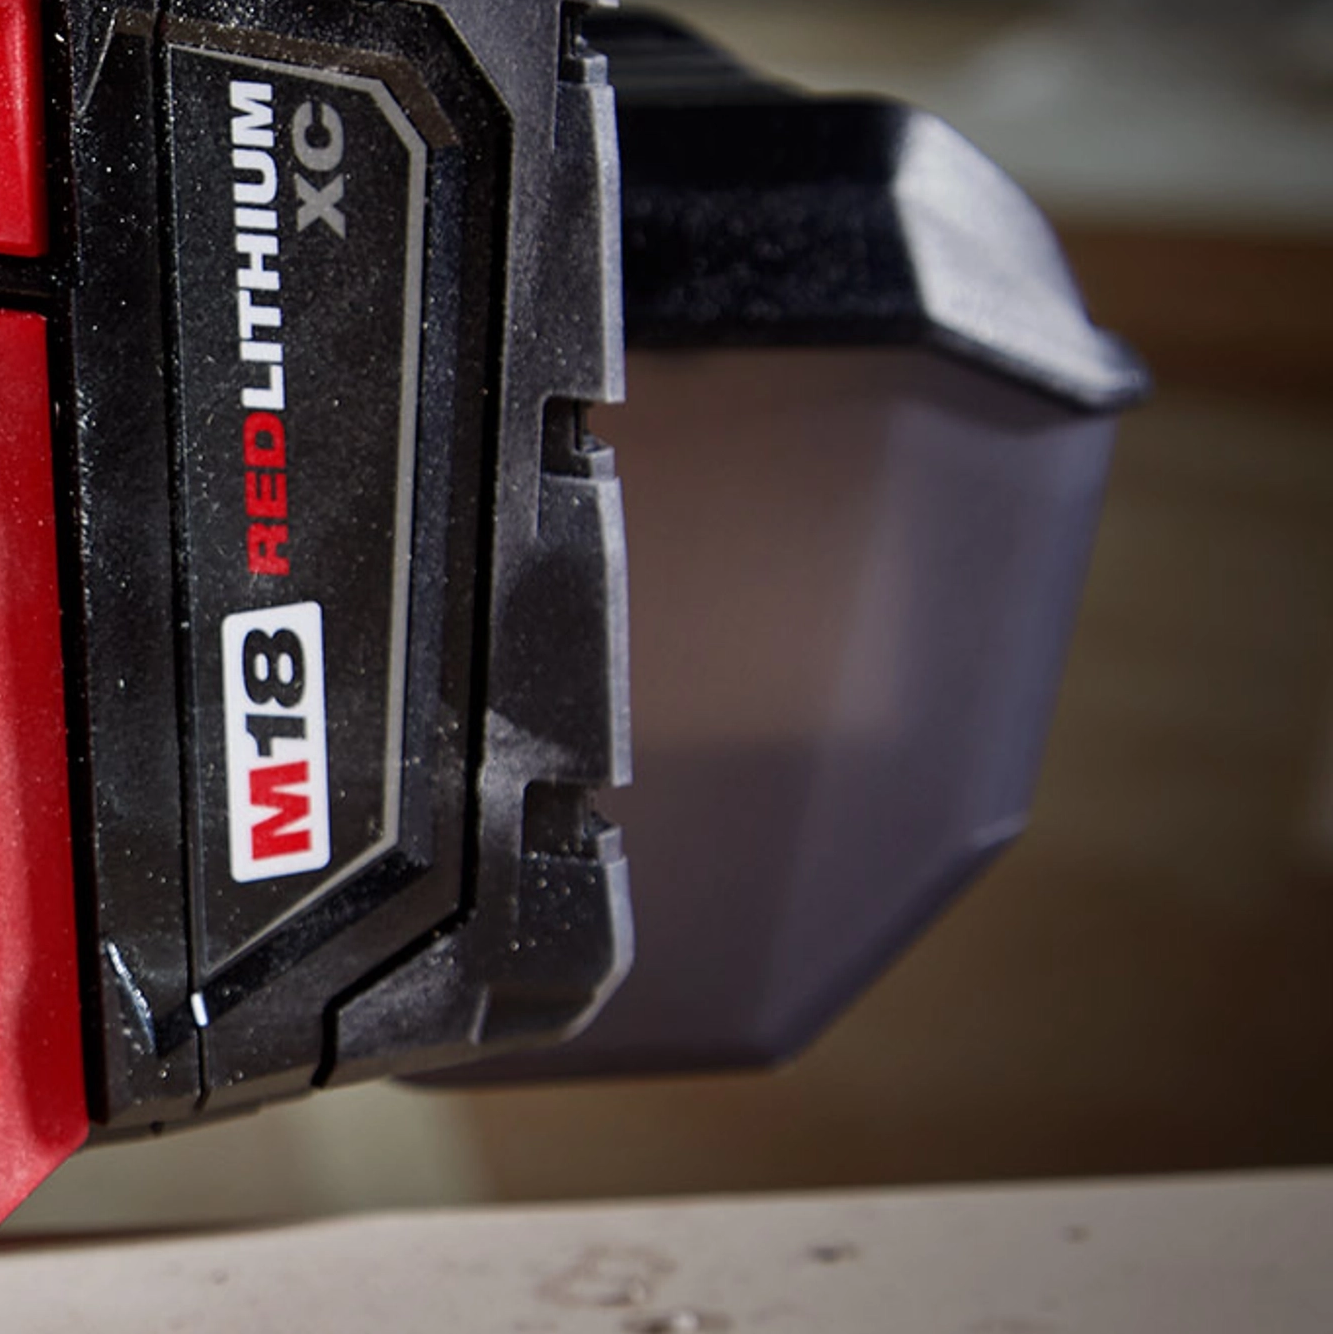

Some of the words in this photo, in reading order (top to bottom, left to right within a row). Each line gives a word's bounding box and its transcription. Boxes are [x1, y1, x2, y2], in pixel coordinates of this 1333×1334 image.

[291, 101, 346, 239] XC
[229, 80, 290, 577] REDLITHIUM
[242, 628, 311, 861] M18
